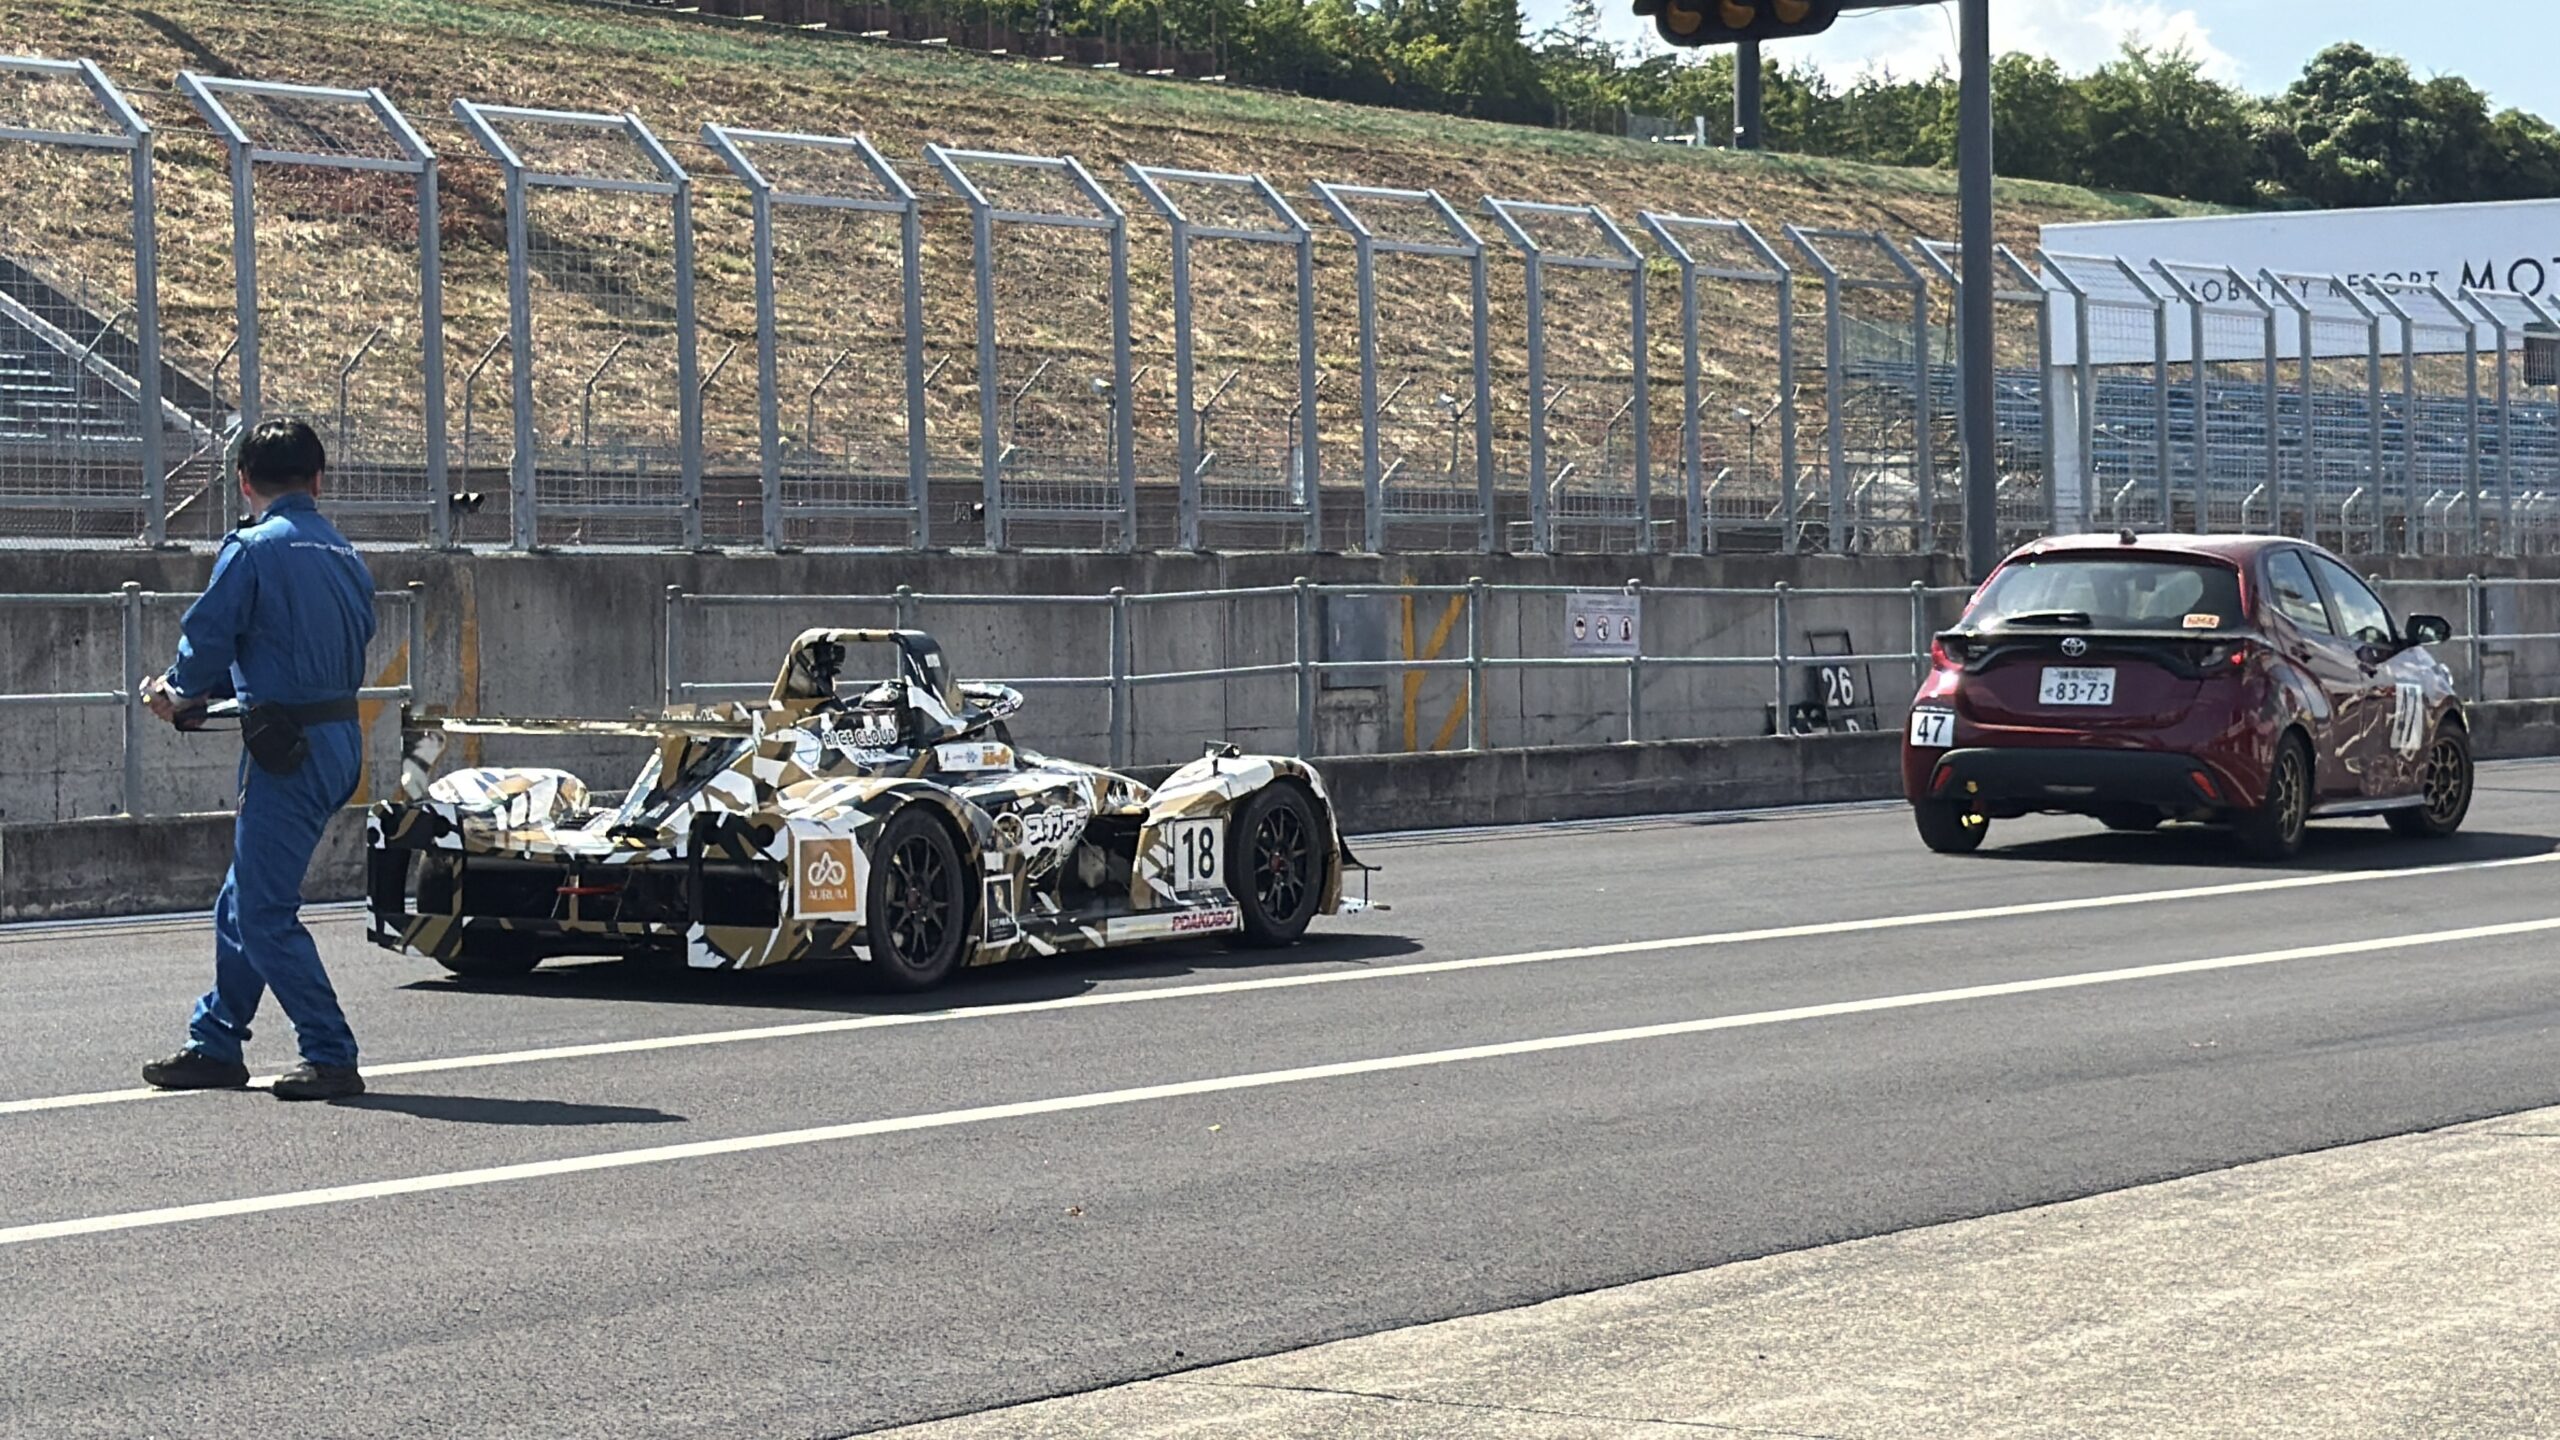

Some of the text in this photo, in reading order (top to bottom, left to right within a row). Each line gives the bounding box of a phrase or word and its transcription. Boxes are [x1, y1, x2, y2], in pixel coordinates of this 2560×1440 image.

[2175, 278, 2309, 303] OBLIY
[2462, 257, 2560, 298] MO
[1822, 666, 1854, 706] 26
[2056, 682, 2110, 702] 83-73
[1917, 715, 1947, 743] 47
[1182, 826, 1215, 879] 18
